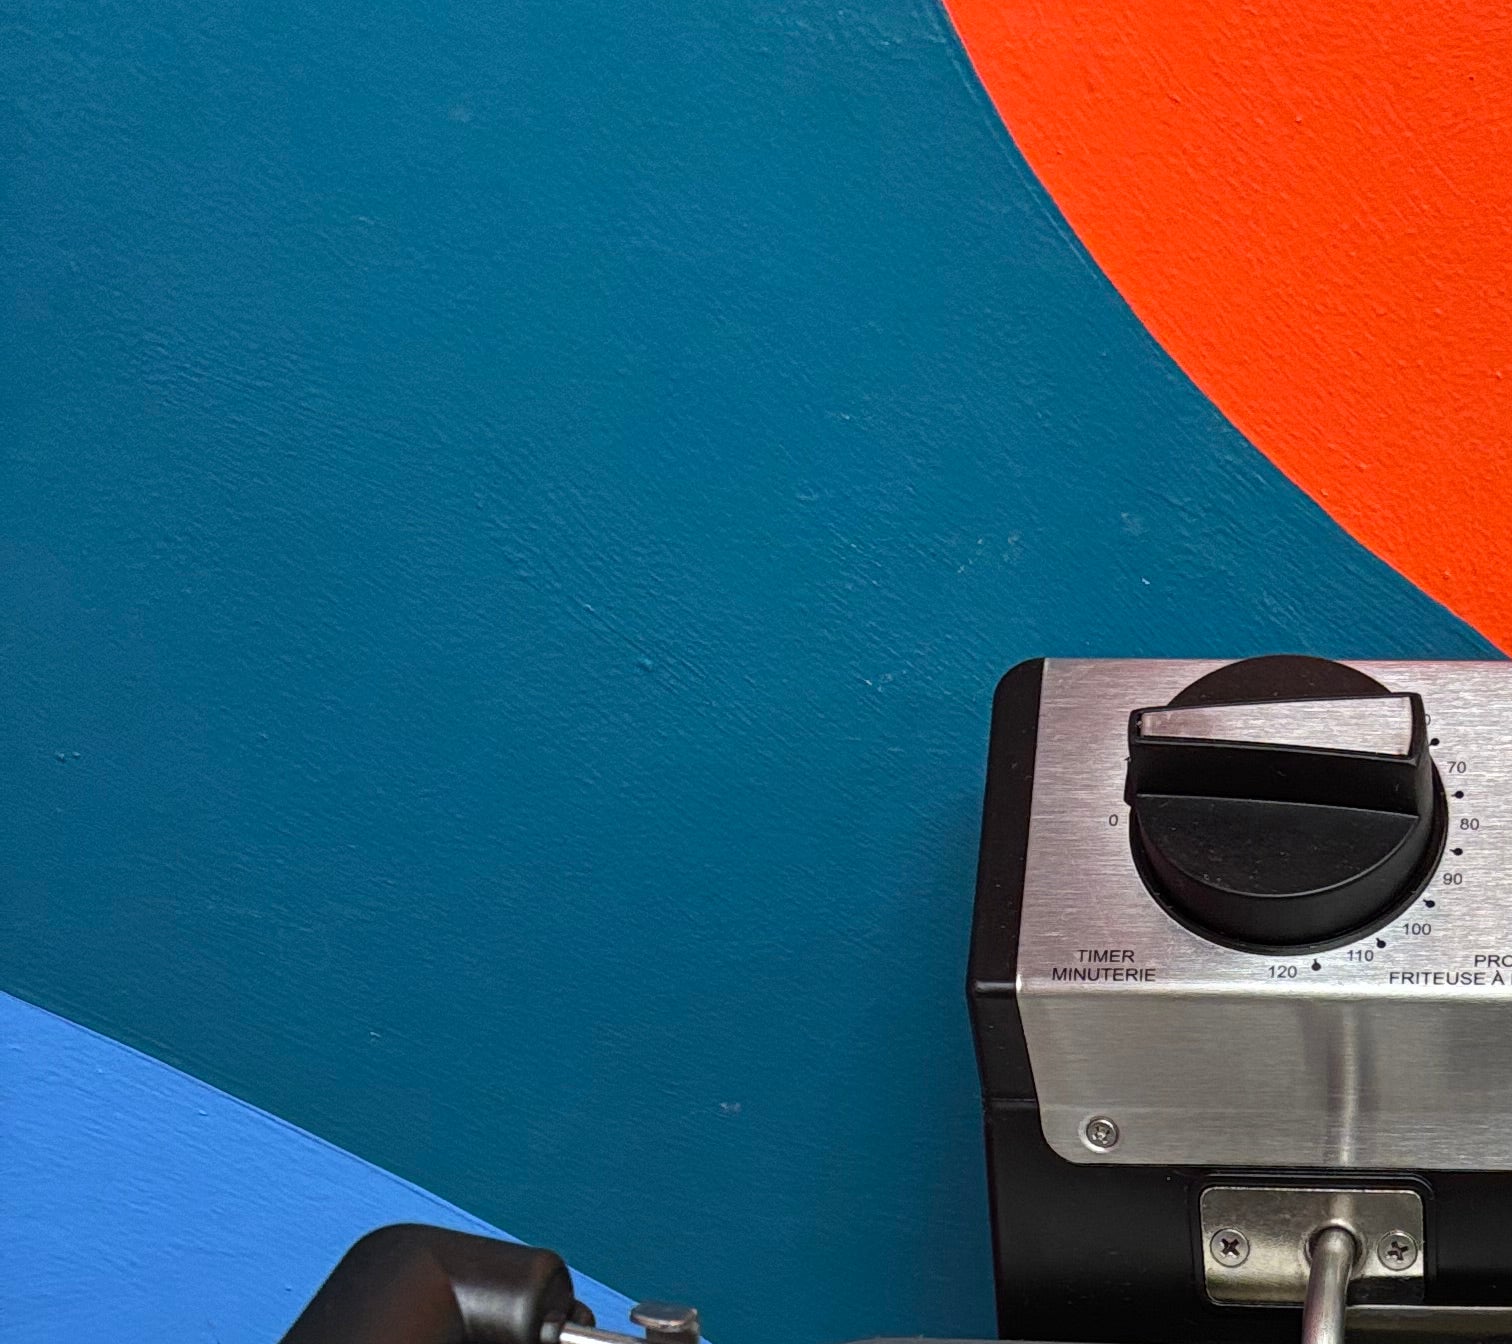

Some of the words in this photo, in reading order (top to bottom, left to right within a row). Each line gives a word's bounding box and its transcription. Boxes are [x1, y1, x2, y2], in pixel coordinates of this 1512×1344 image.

[1447, 761, 1467, 774] 70
[1108, 815, 1119, 827] 0
[1460, 819, 1479, 831] 80
[1443, 873, 1463, 885] 90
[1403, 923, 1432, 936] 100
[1077, 950, 1135, 963] TIMER
[1347, 950, 1374, 962] 110
[1052, 967, 1156, 982] MINUTERIE
[1268, 966, 1297, 979] 120
[1389, 971, 1486, 985] FRITEUSE
[1491, 968, 1507, 986] À
